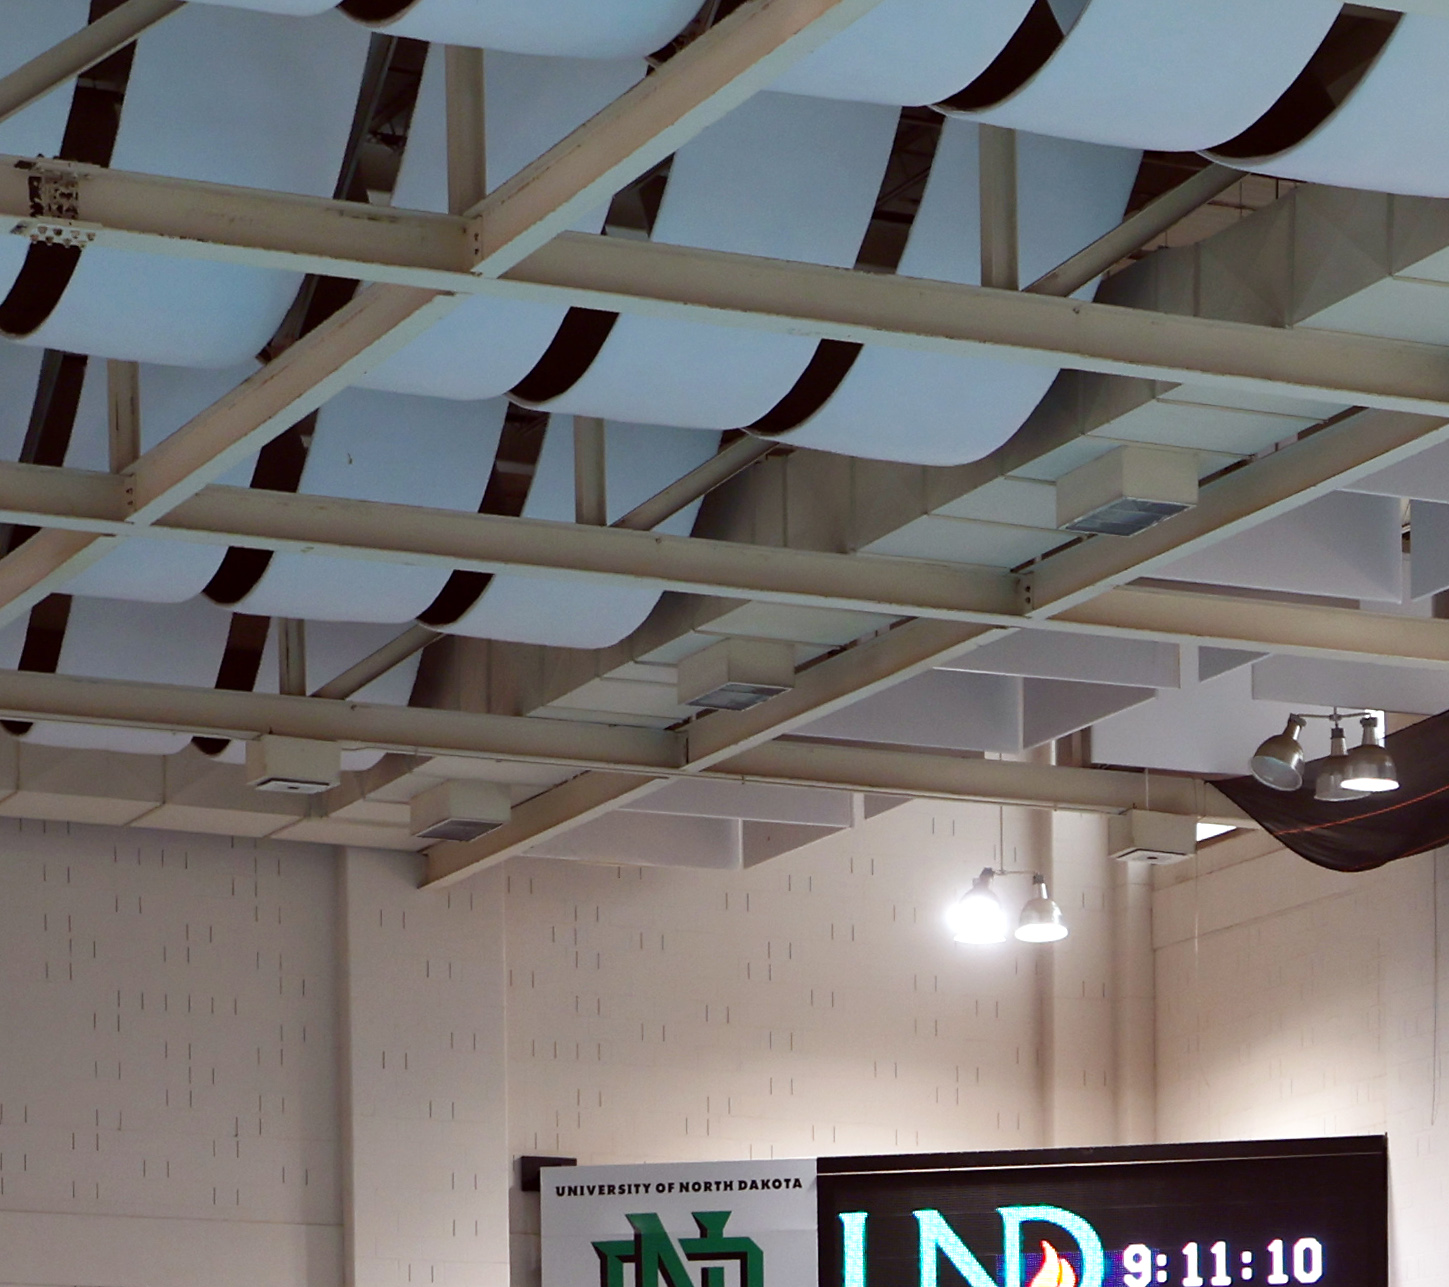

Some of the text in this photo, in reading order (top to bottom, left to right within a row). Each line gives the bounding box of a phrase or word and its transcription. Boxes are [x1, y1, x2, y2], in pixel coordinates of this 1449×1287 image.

[556, 1178, 802, 1197] UNIVERSITY OF NORTH DAKOTA
